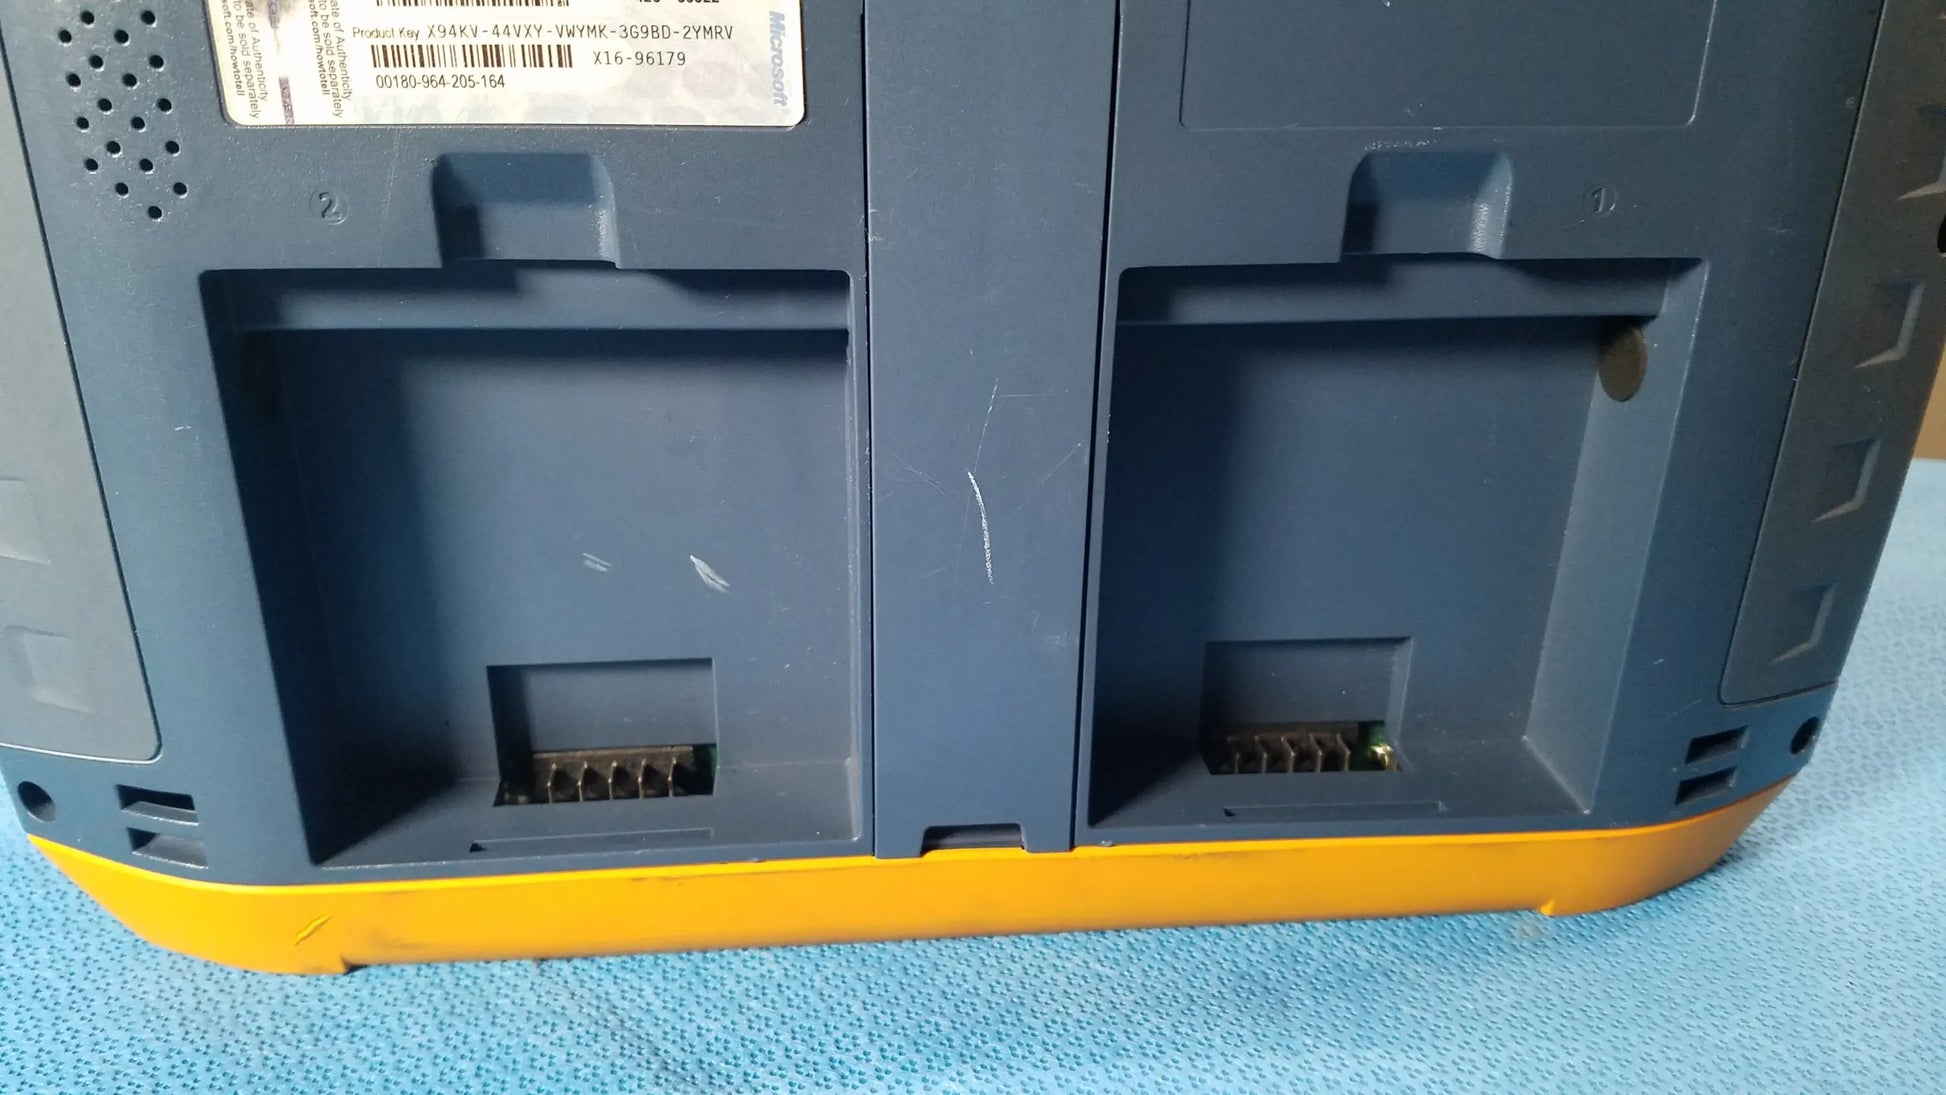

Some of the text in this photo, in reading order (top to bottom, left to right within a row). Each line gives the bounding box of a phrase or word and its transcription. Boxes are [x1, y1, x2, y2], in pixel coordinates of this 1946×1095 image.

[236, 15, 245, 29] be
[248, 22, 259, 33] of
[320, 14, 330, 29] be
[333, 22, 344, 33] of
[352, 24, 733, 41] Product Key X94KV-44VXY-VWYMK-3G9BD-2YMRV
[239, 33, 251, 57] sold
[323, 32, 335, 57] sold
[593, 50, 686, 66] X16-96179
[769, 10, 788, 107] Microsoft
[251, 36, 268, 101] Authenticity
[336, 36, 352, 101] Authenticity
[243, 60, 262, 119] separately
[327, 60, 345, 118] separately
[376, 74, 506, 89] 00180-964-205-164
